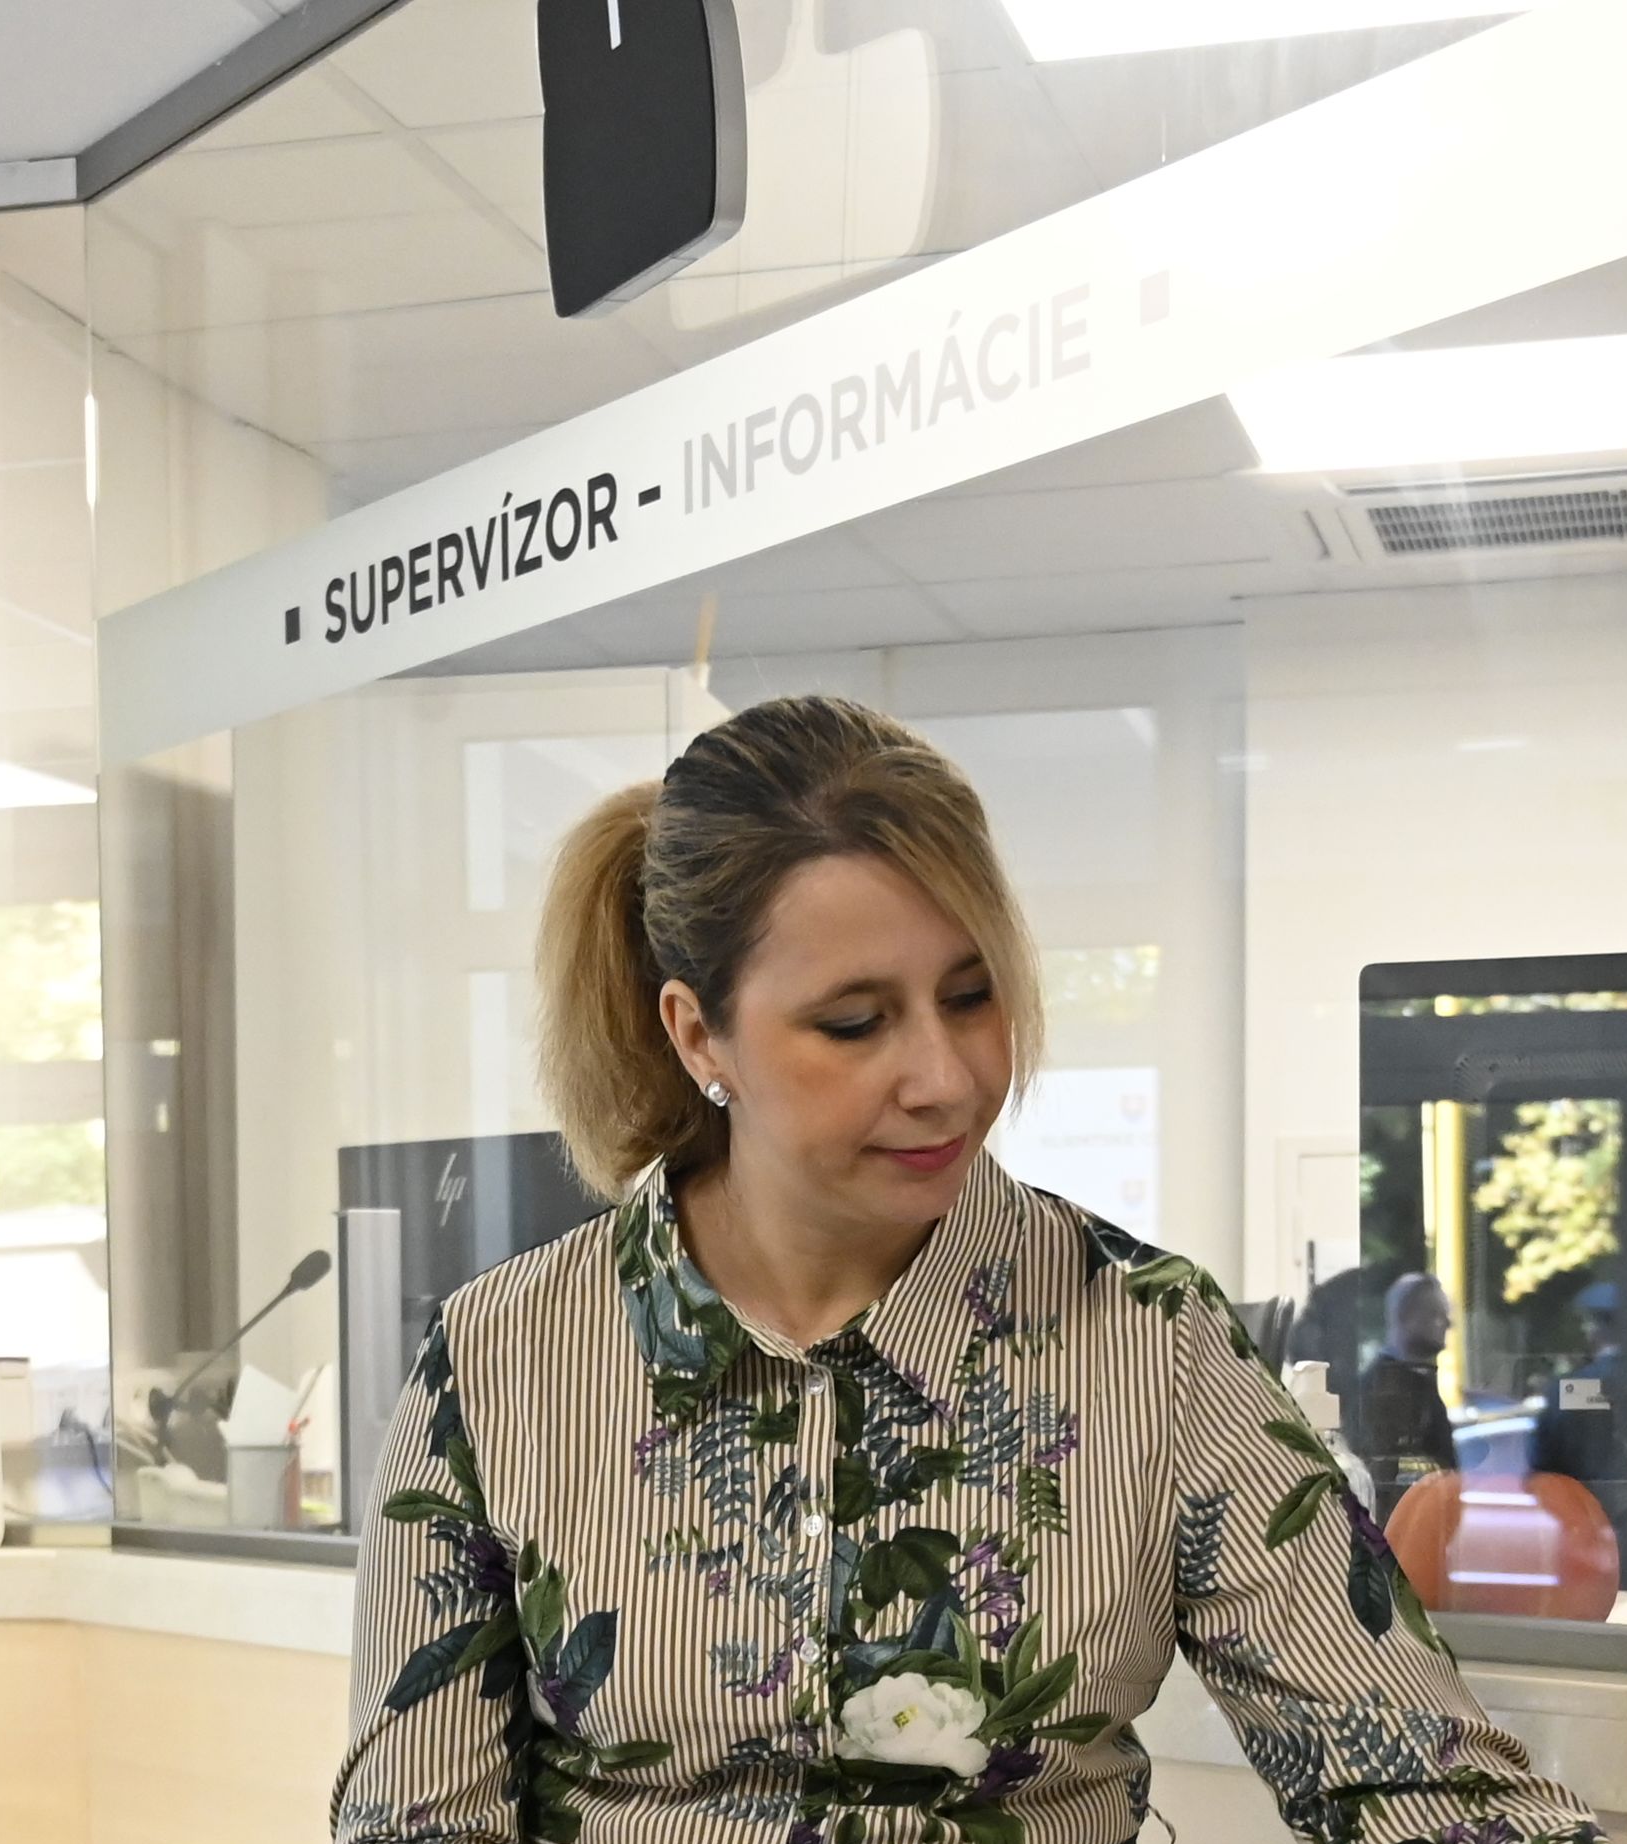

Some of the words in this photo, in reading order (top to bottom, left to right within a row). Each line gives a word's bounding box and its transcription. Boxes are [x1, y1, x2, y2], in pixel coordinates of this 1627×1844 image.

[325, 472, 618, 643] SUPERVÍZOR
[683, 282, 1091, 515] INFORMÁCIE
[435, 1152, 467, 1228] hp
